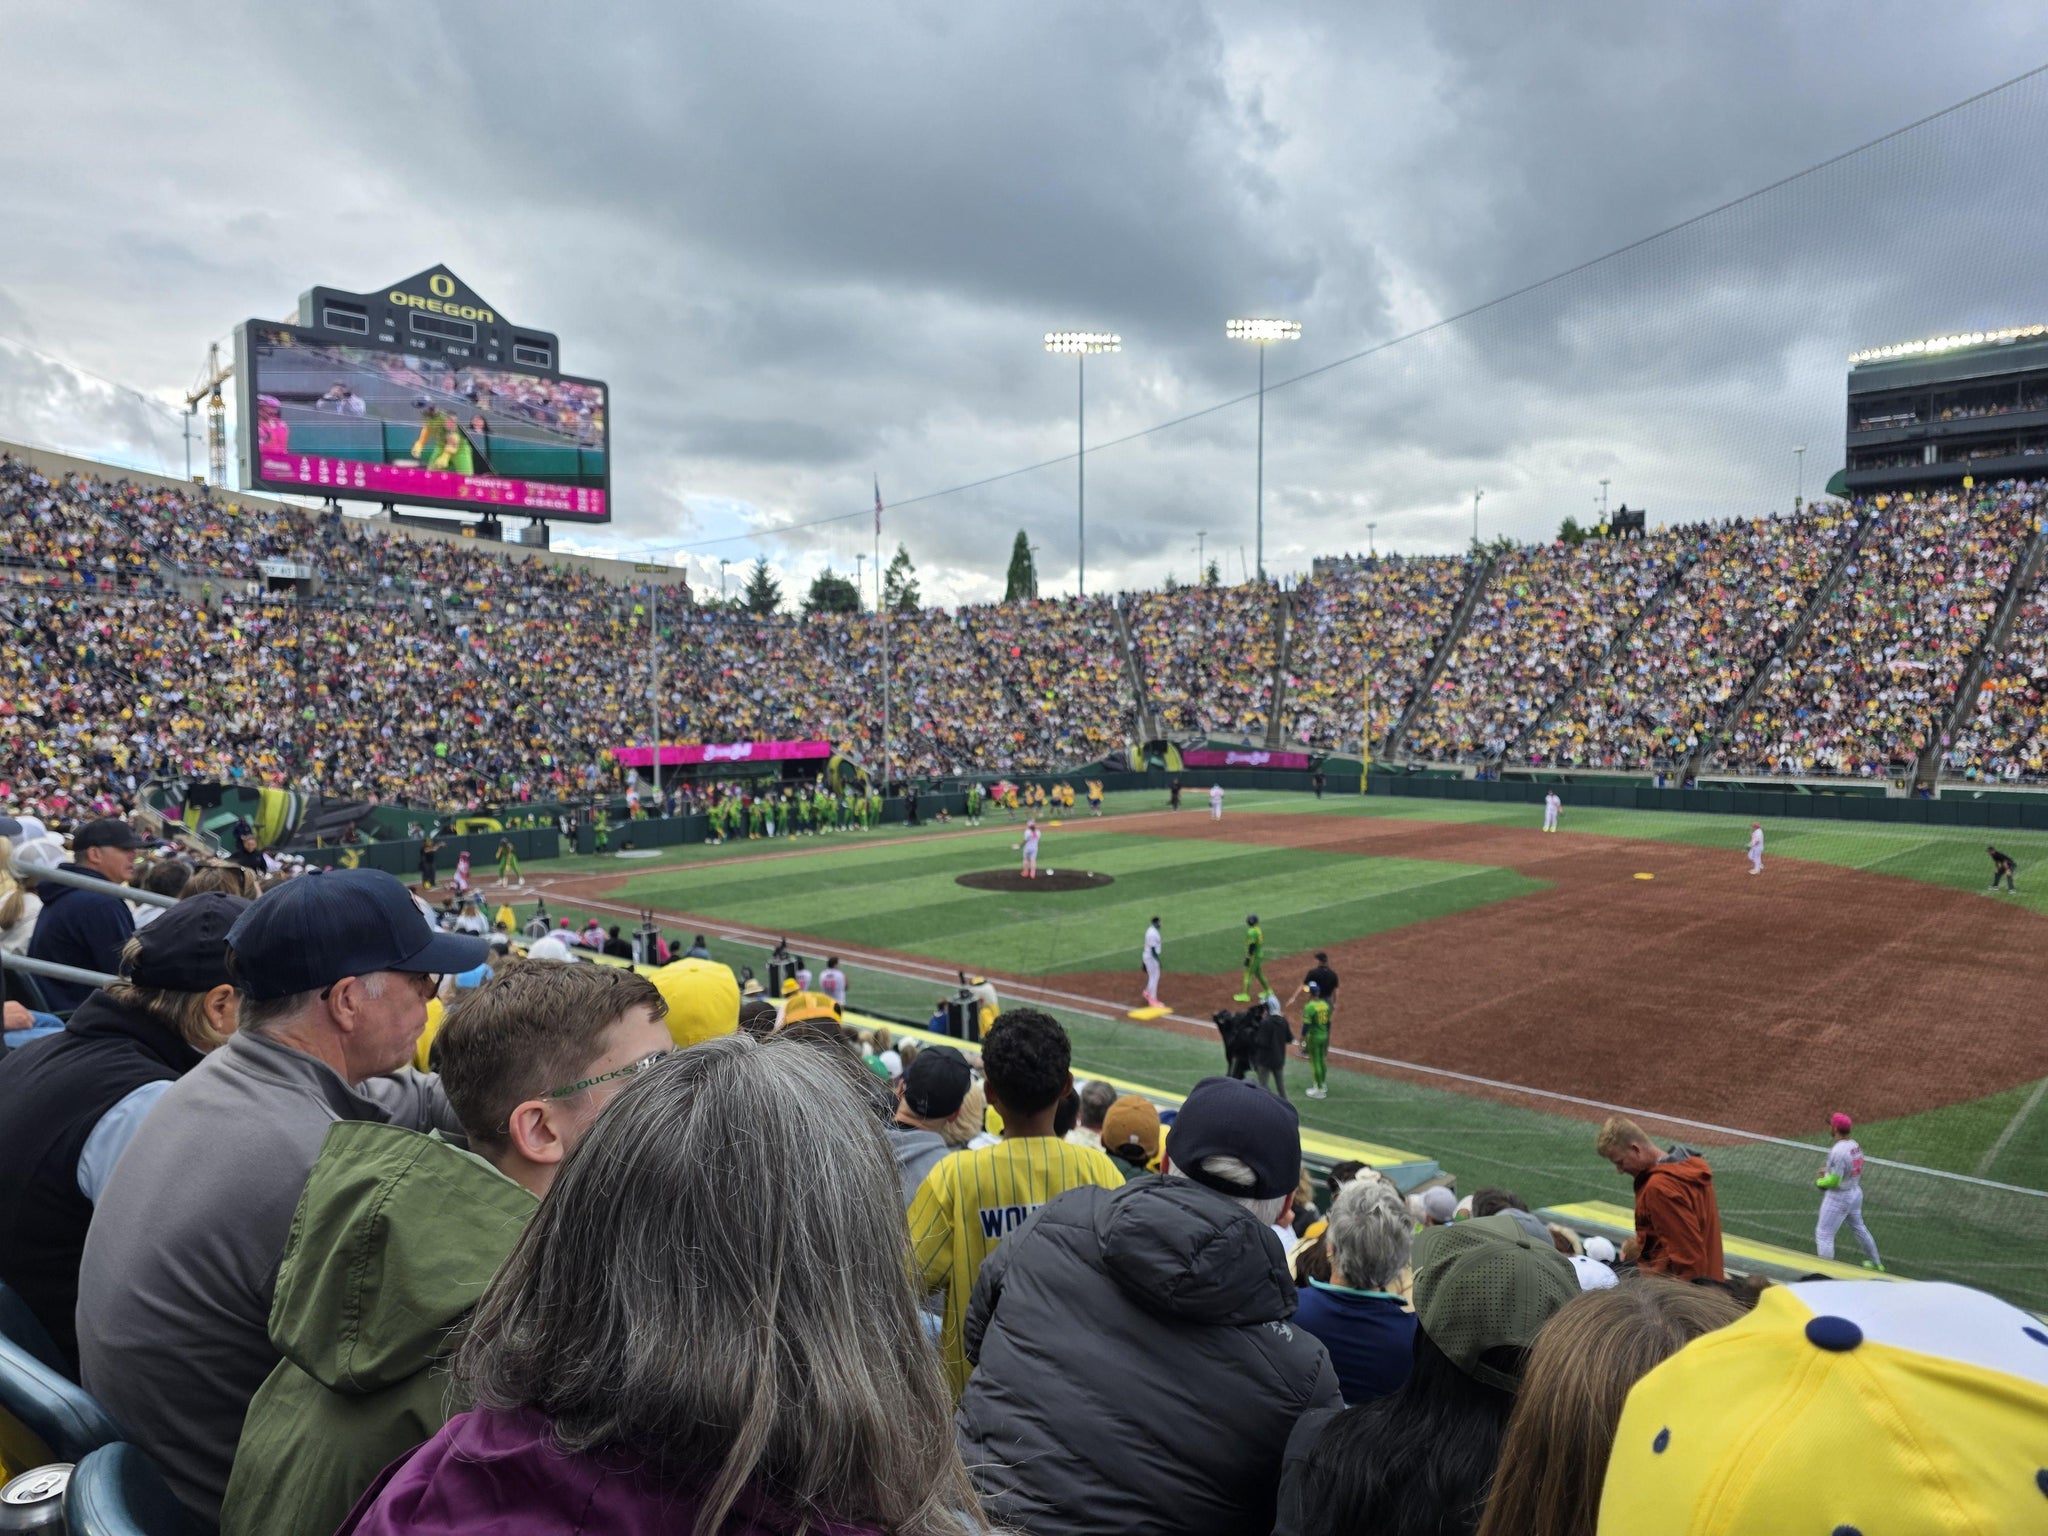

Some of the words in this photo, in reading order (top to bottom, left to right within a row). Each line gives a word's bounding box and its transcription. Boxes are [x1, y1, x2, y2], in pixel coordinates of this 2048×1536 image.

[429, 273, 456, 298] O
[389, 290, 494, 324] OREGON
[551, 1085, 575, 1099] GO
[576, 1065, 634, 1091] DUCKS
